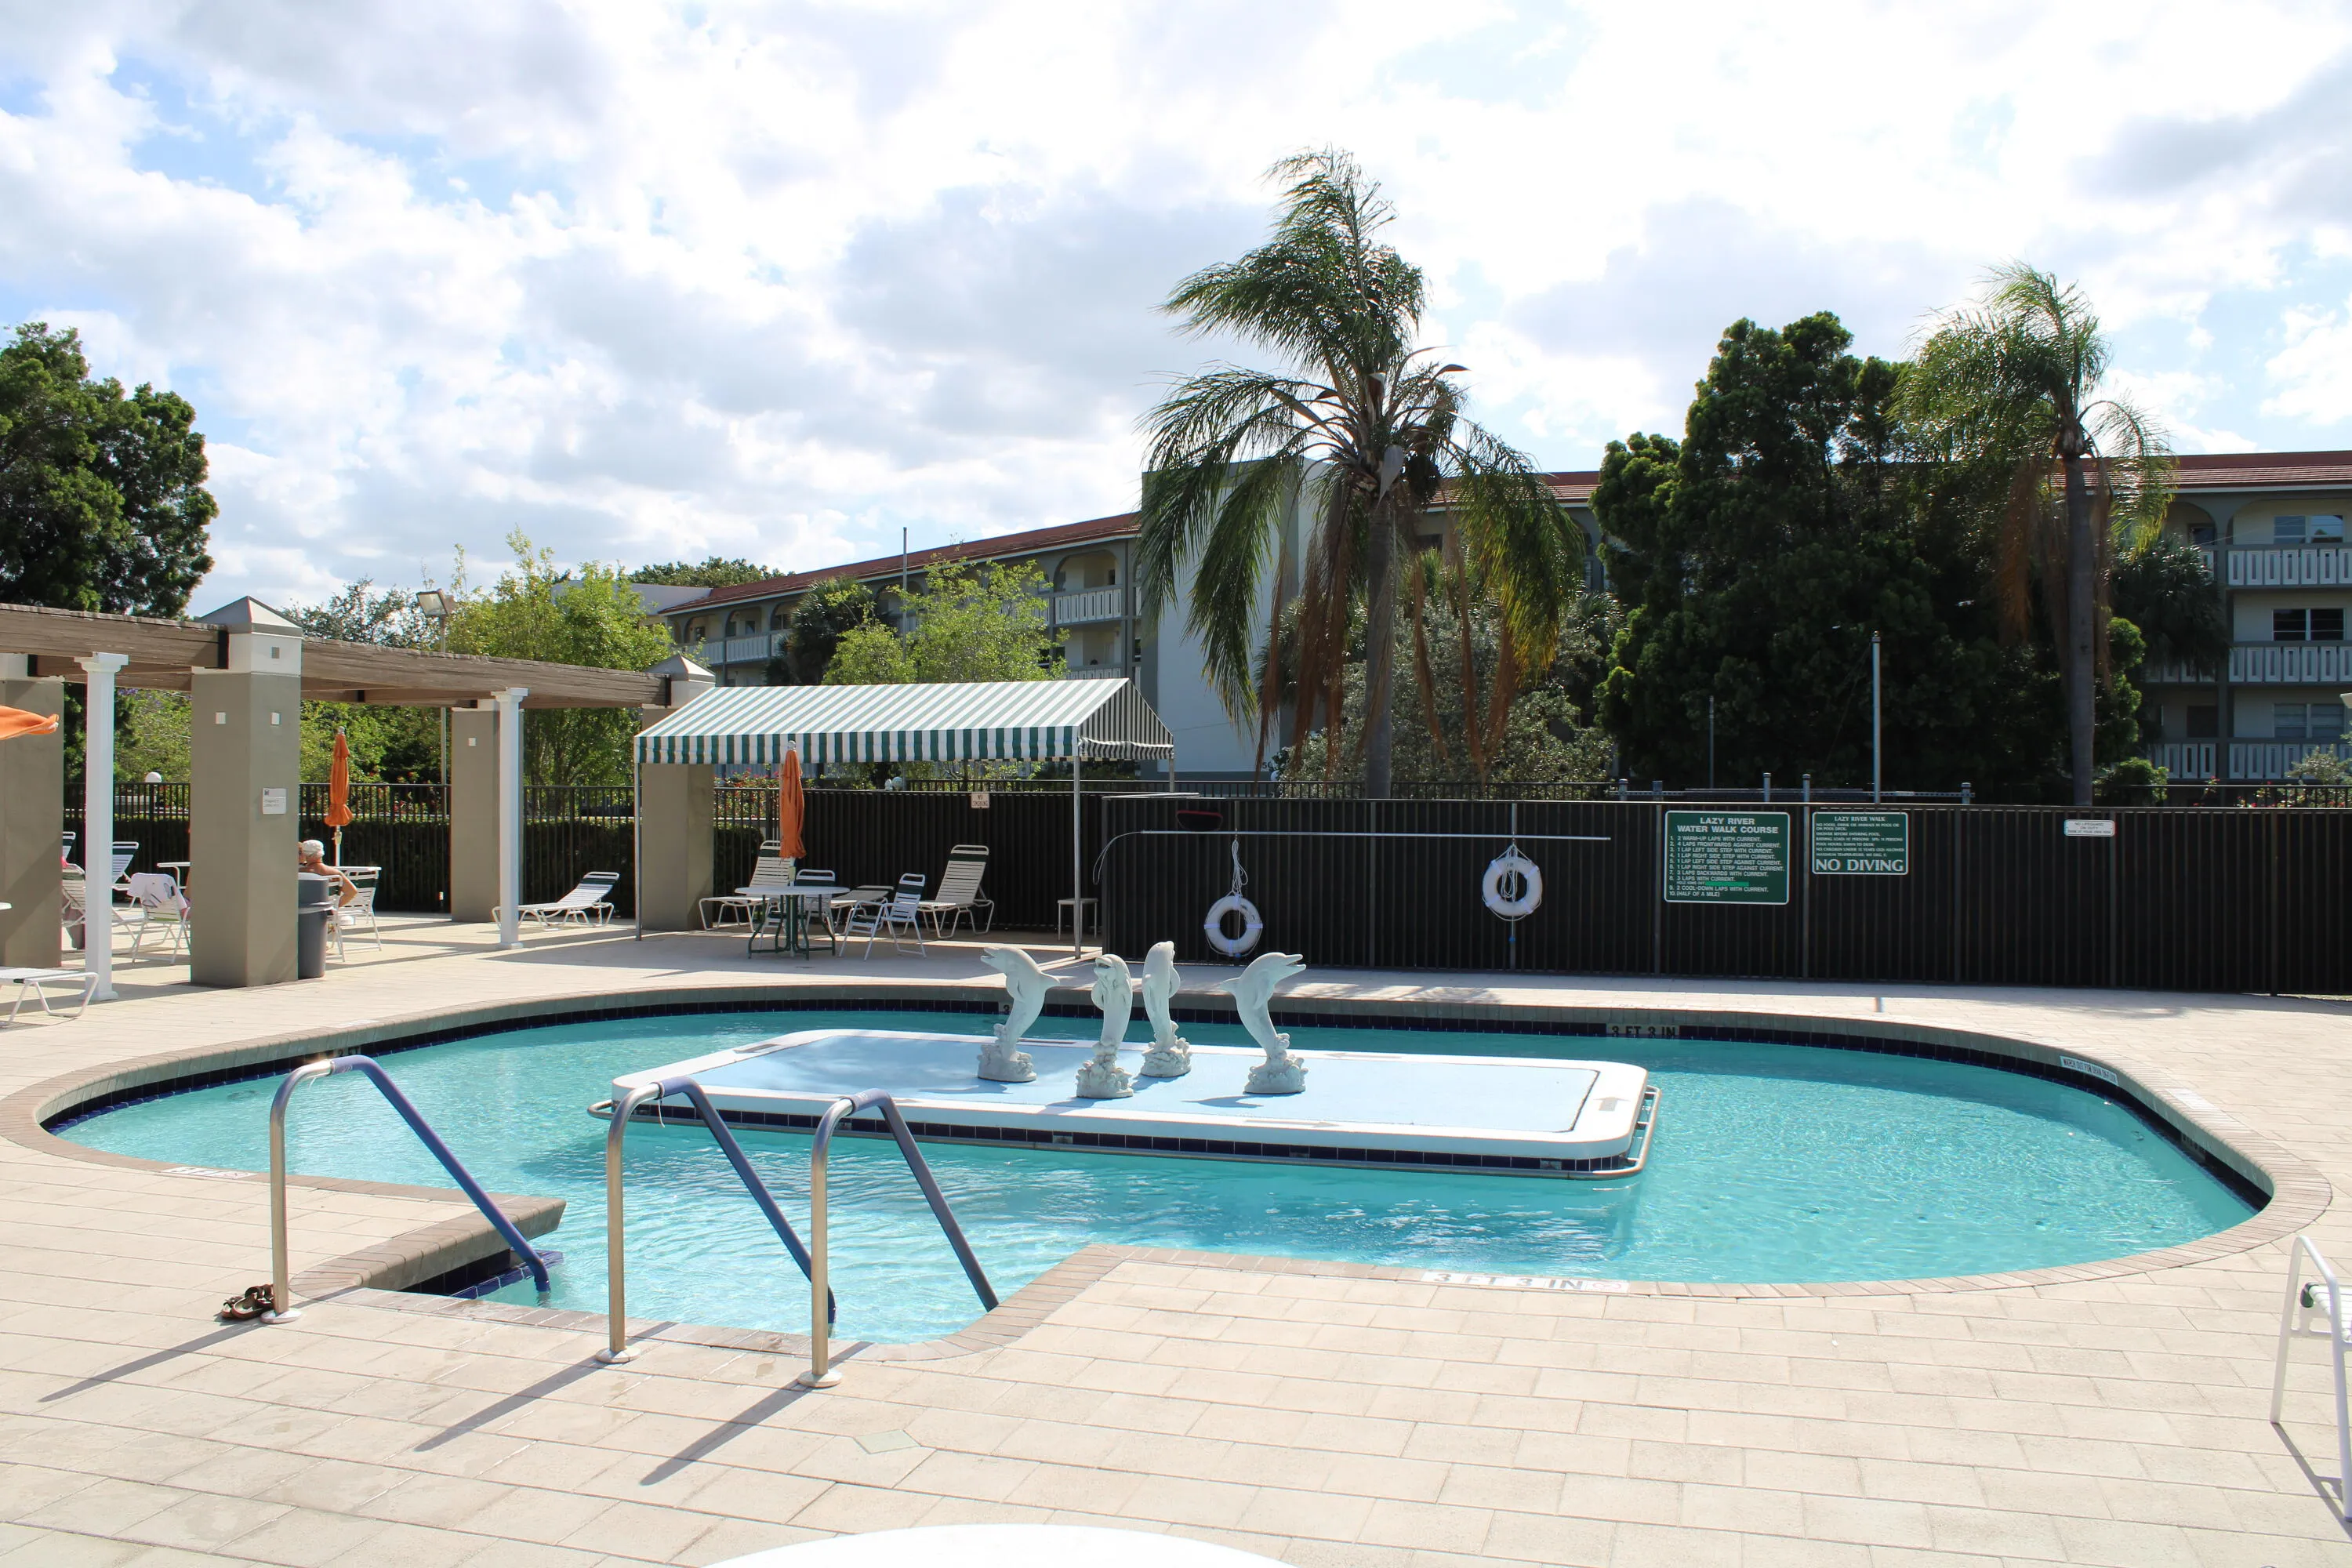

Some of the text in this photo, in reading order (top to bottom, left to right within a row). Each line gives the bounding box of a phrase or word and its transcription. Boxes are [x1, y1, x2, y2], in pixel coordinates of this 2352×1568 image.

[1816, 858, 1904, 872] NO DIVING
[1625, 1025, 1642, 1036] FT
[1661, 1026, 1675, 1036] IN
[1435, 1273, 1584, 1290] 3 FT 3 IN
